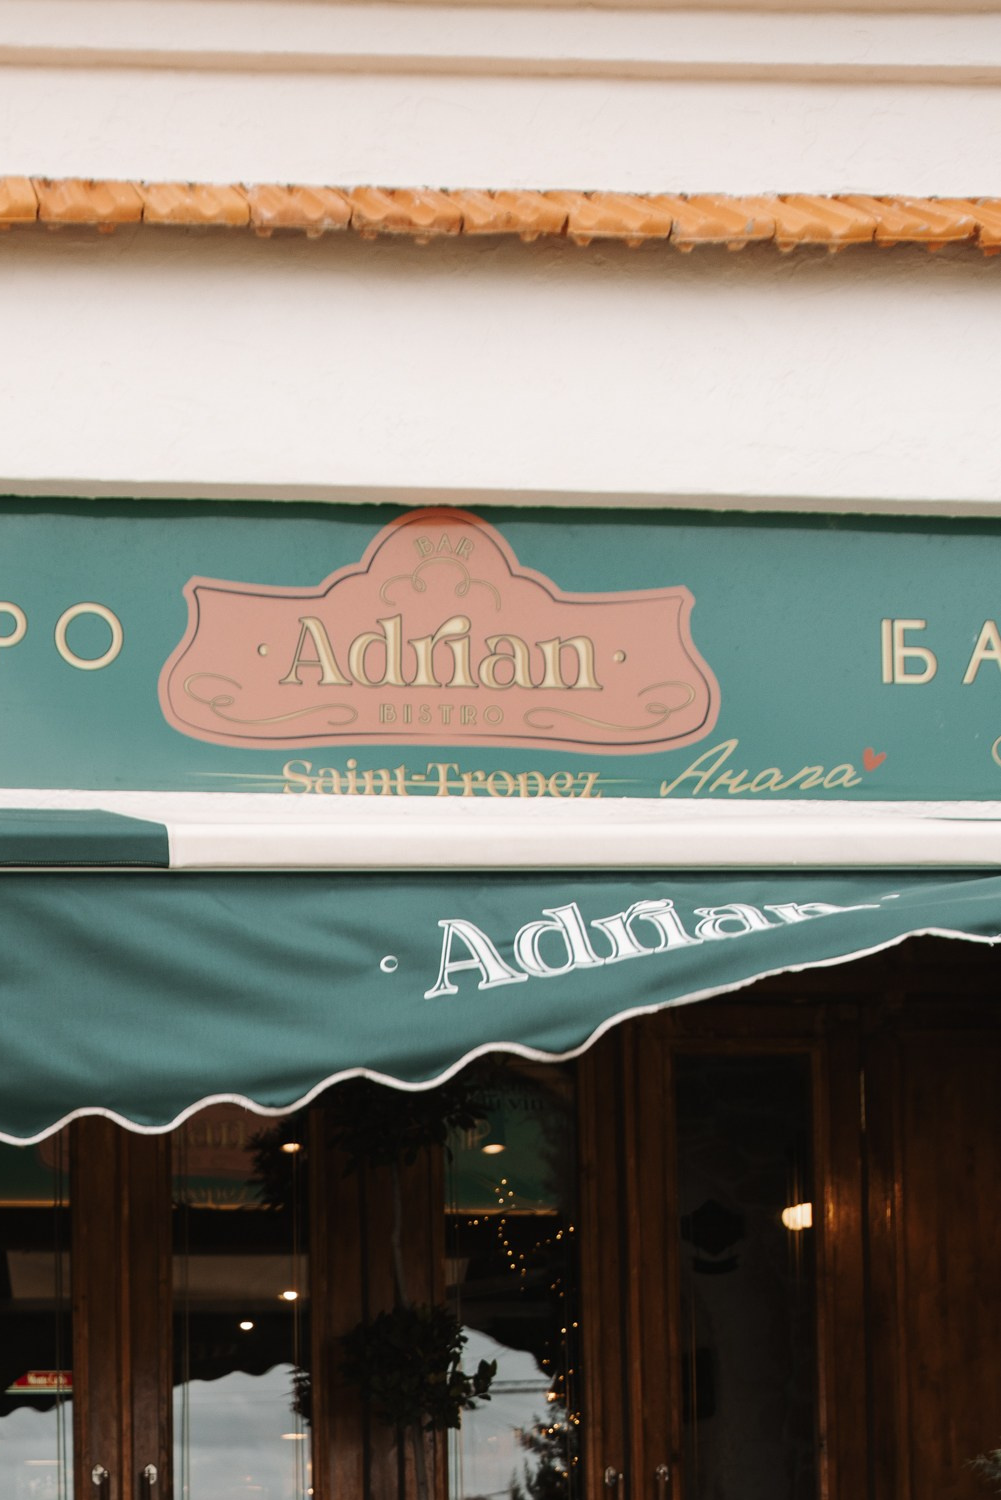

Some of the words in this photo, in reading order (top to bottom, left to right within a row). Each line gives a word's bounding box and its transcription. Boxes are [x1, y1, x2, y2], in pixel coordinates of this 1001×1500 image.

[414, 533, 475, 560] BAR
[279, 613, 604, 691] Adrian
[378, 703, 504, 726] BISTRO
[281, 757, 605, 798] Saint-Tropez
